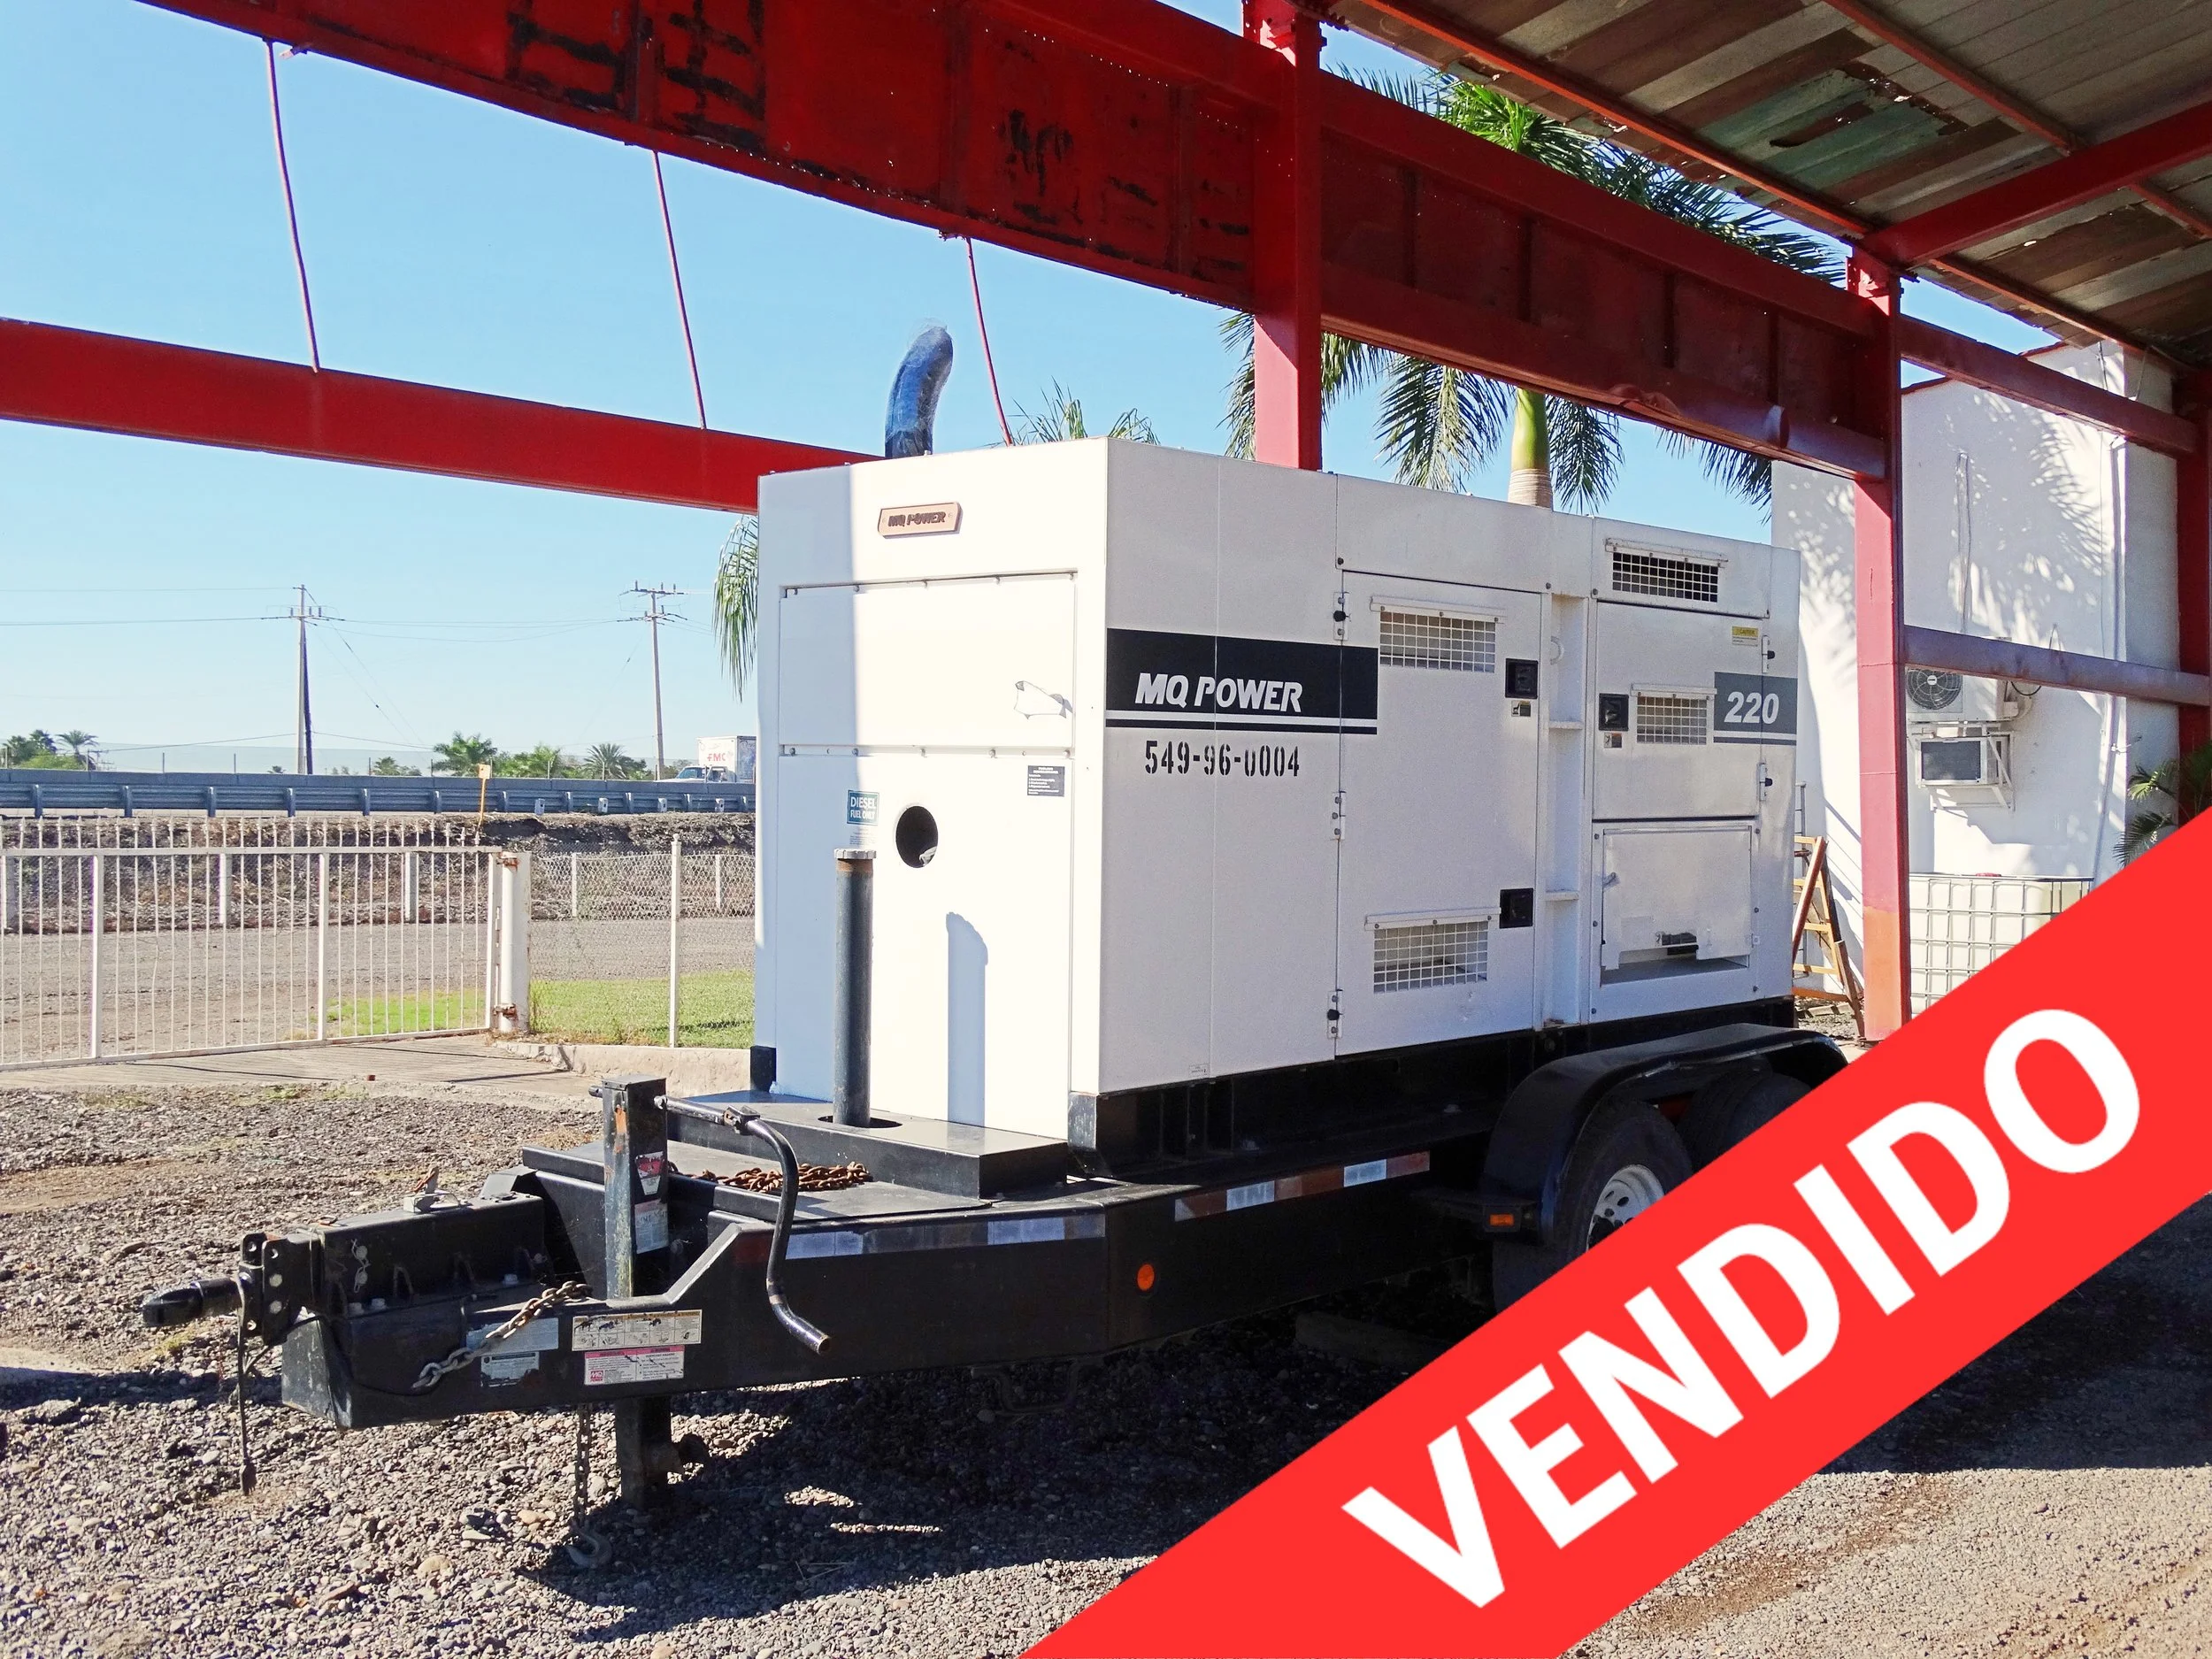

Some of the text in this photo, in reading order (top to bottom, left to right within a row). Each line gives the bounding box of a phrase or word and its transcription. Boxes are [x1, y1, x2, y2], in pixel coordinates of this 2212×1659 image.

[888, 511, 946, 526] MQ POWER
[1135, 673, 1303, 712] MQ POWER
[1724, 691, 1779, 724] 220
[1145, 740, 1300, 777] 549-96-0004
[850, 796, 876, 809] DIESEL
[850, 809, 874, 819] FUEL ONLY
